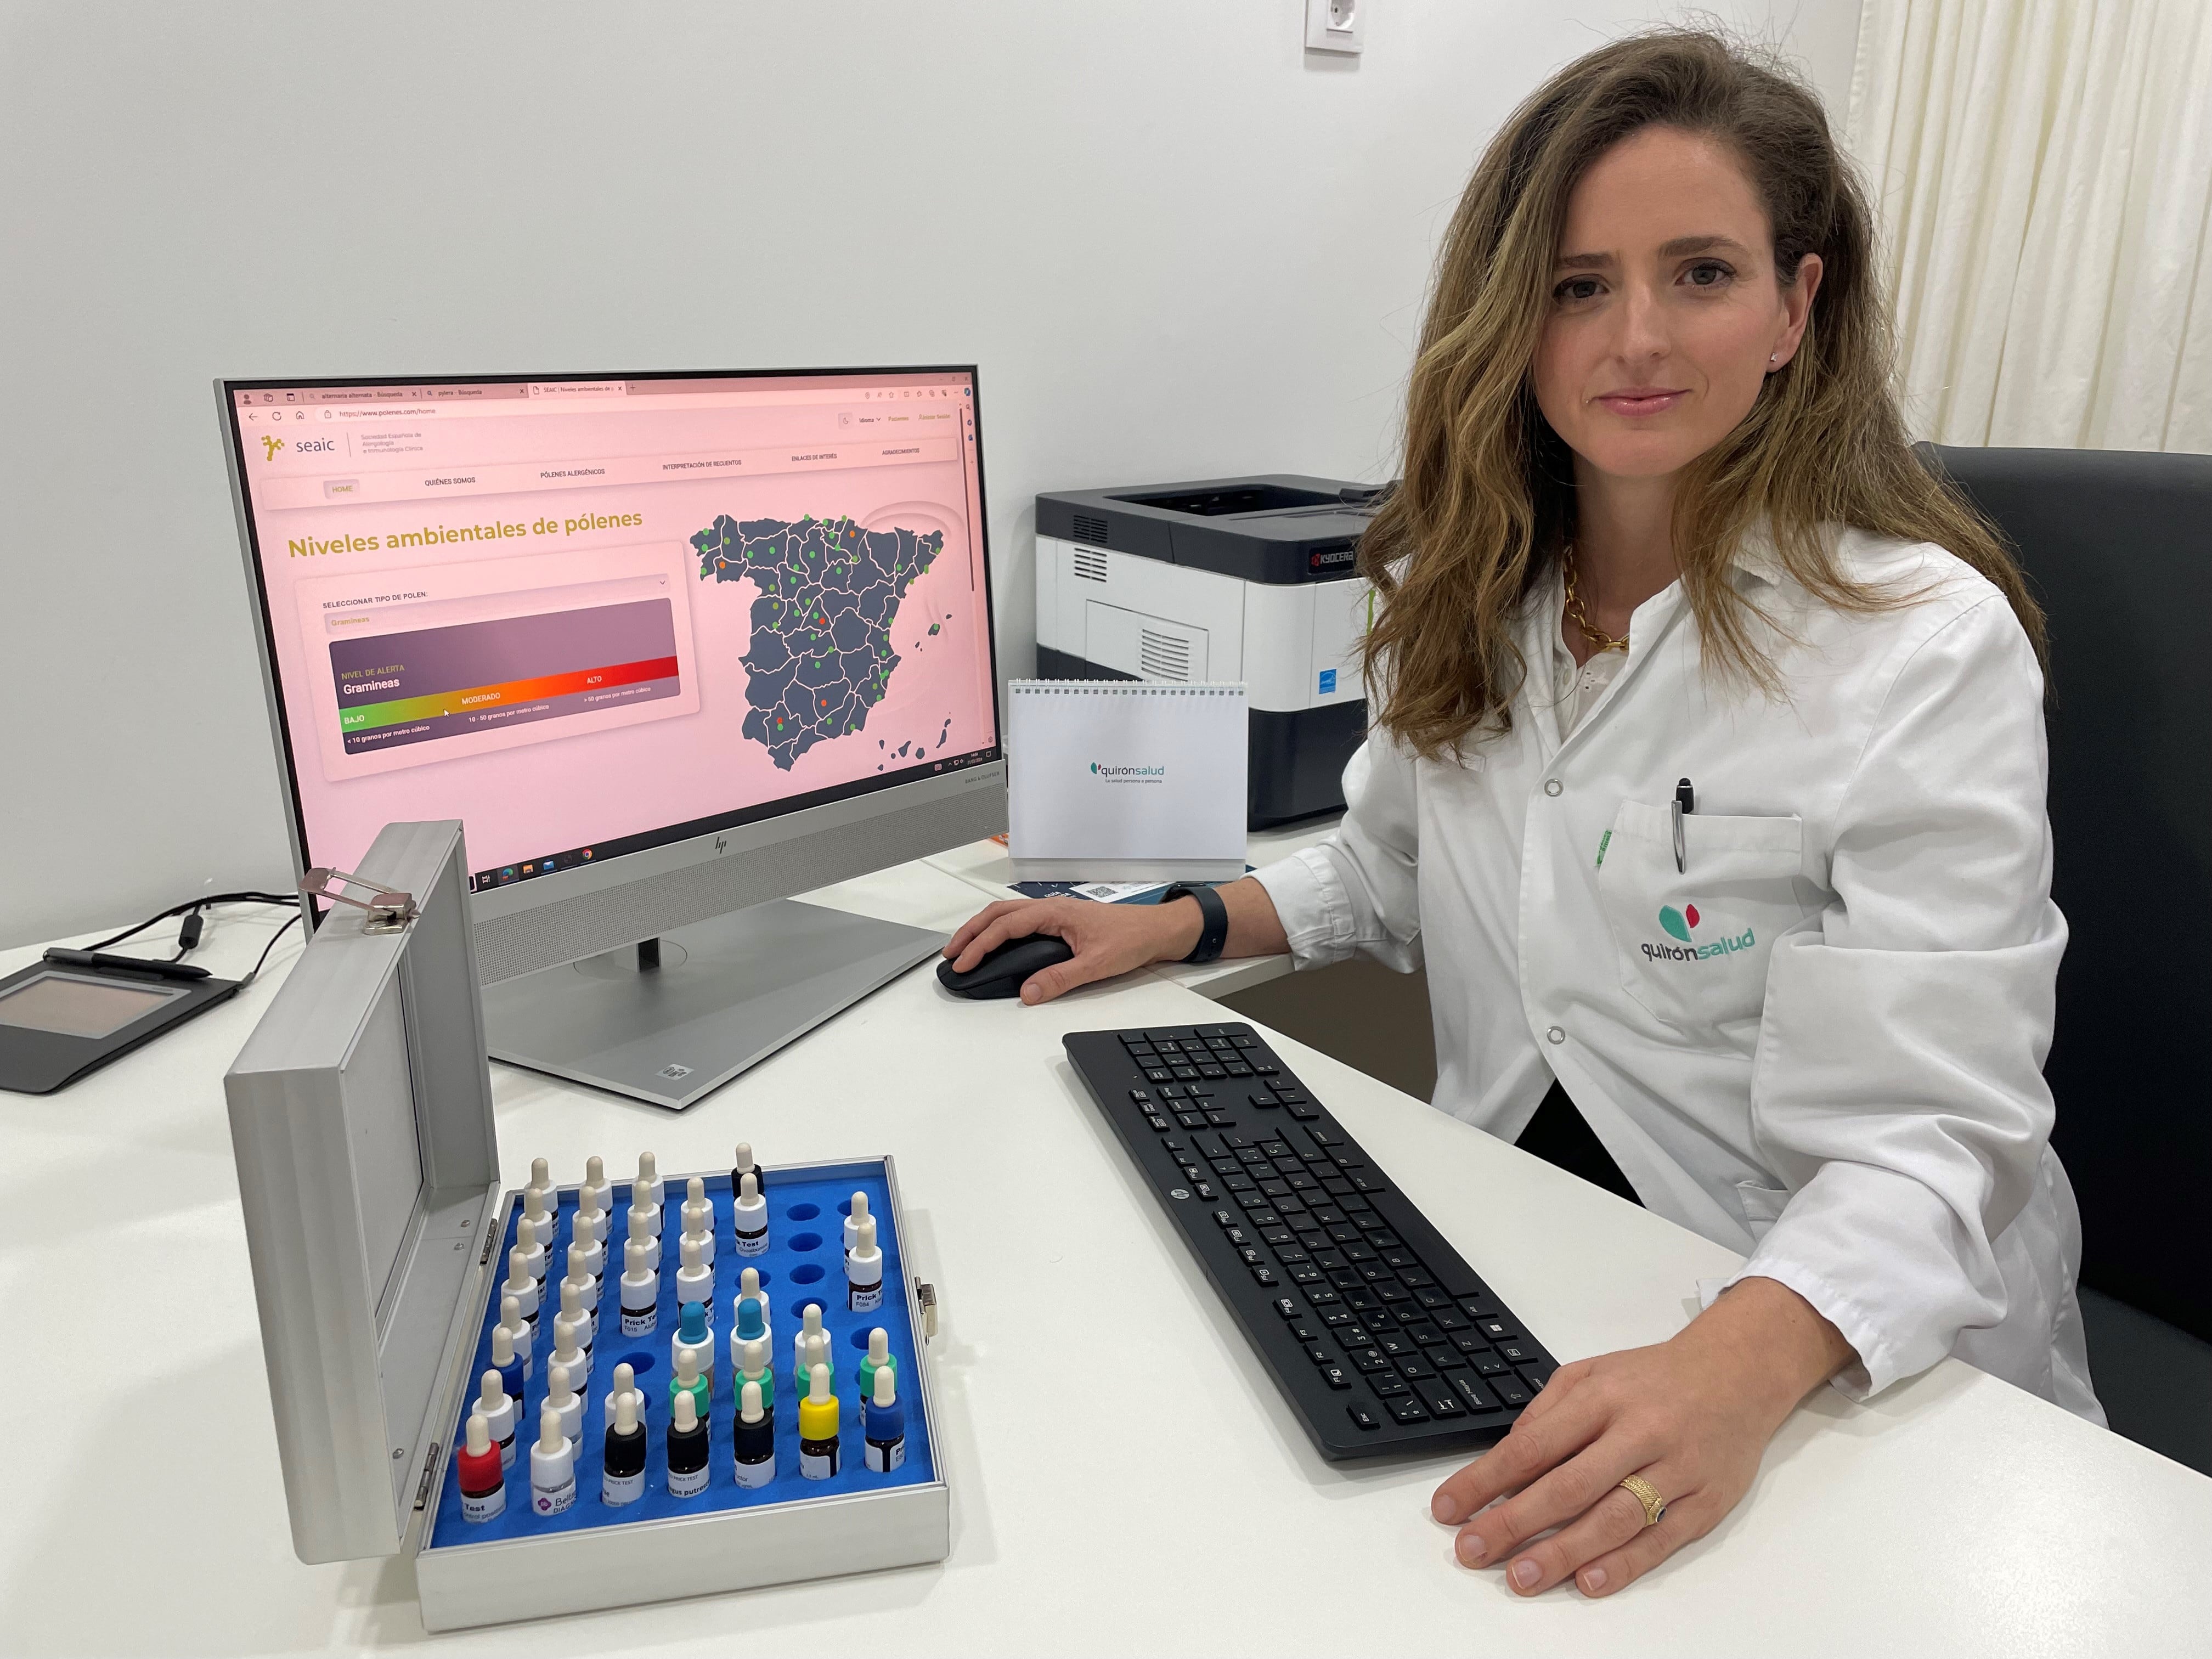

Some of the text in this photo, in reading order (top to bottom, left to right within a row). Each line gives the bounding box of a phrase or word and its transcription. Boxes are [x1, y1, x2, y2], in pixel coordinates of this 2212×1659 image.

[340, 408, 436, 417] https://www.polenes.com/home
[296, 437, 335, 452] seaic
[662, 460, 705, 470] INTERPRETACIÓN
[567, 469, 605, 477] ALERGÉNICOS
[425, 478, 452, 487] QUIÉNES
[289, 511, 642, 558] Niveles ambientales de pólenes
[1320, 551, 1354, 565] KYOCERA
[323, 597, 373, 609] SELECCIONAR
[341, 671, 363, 680] NIVEL
[377, 664, 405, 674] ALERTA
[586, 675, 602, 685] ALTO
[343, 679, 400, 695] Gramineas
[461, 692, 501, 706] MODERADO
[344, 715, 365, 724] BAJO
[488, 712, 506, 721] granos
[361, 733, 382, 743] granos
[411, 725, 430, 733] cúbico
[1640, 927, 1756, 962] quirónsalud
[1387, 1342, 1398, 1351] W
[464, 1503, 486, 1511] Test
